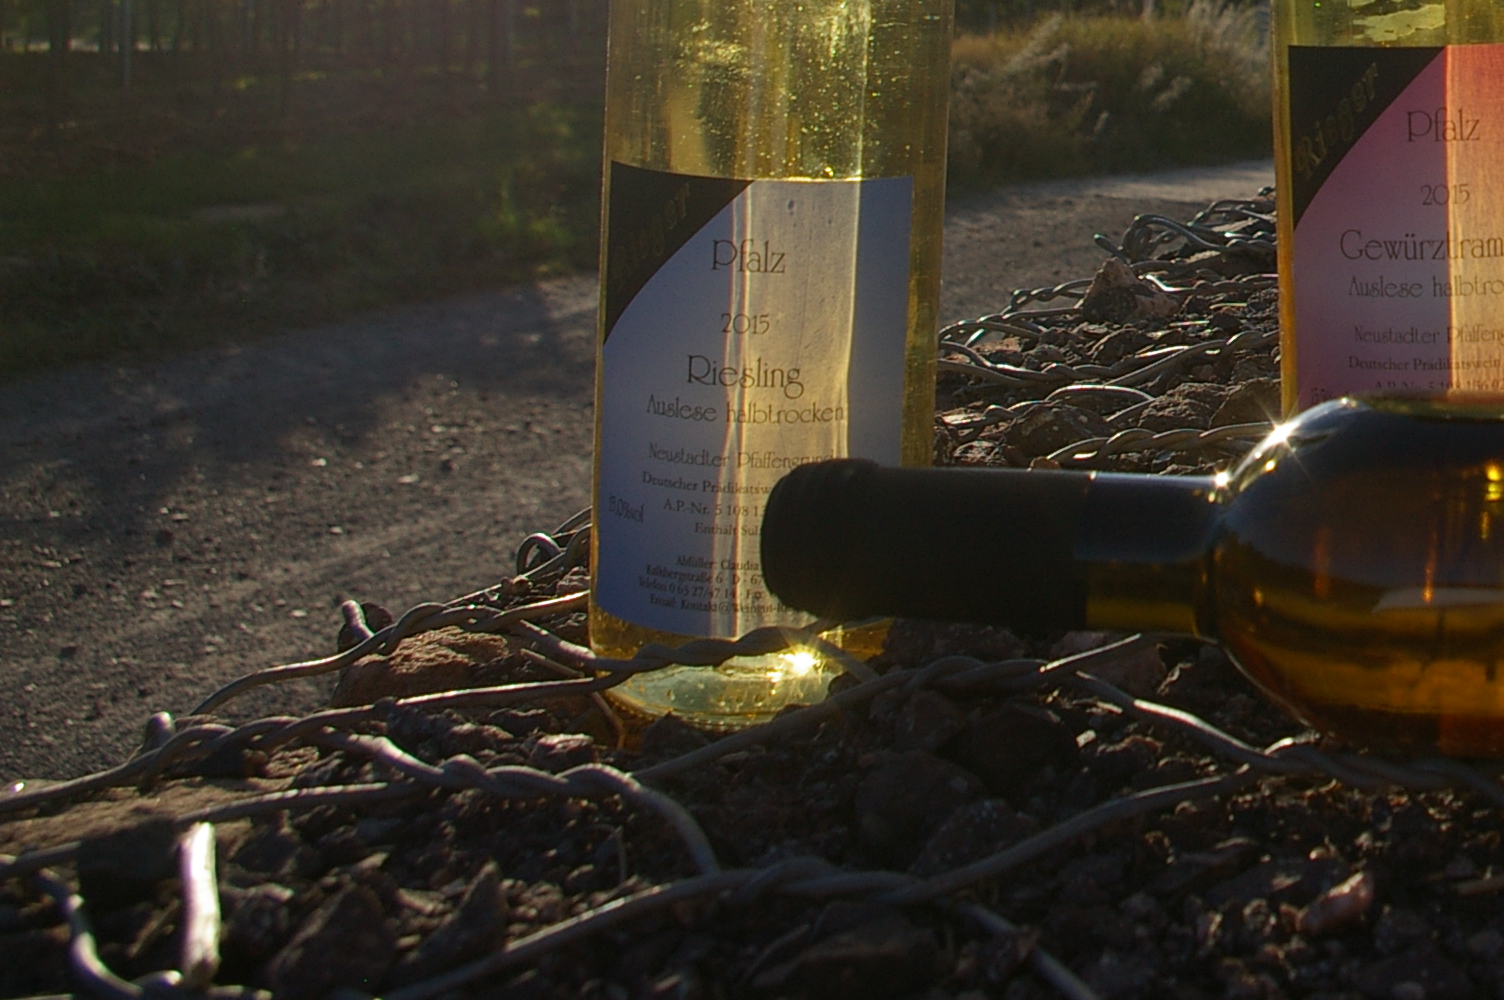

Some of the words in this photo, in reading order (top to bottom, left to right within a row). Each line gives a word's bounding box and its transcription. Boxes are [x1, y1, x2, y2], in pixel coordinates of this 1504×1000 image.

[1296, 62, 1380, 180] Rieger
[1406, 107, 1481, 143] Pfalz
[1421, 183, 1471, 206] 2015
[710, 238, 787, 274] Pfalz
[1347, 276, 1423, 298] Auslese
[721, 312, 770, 336] 2015
[1348, 356, 1409, 371] Deutscher
[685, 354, 805, 400] Riesling
[646, 393, 718, 423] Auslese
[726, 400, 845, 425] halbtrocken
[642, 471, 698, 492] Deutscher
[715, 503, 723, 517] 5
[727, 504, 749, 518] 108
